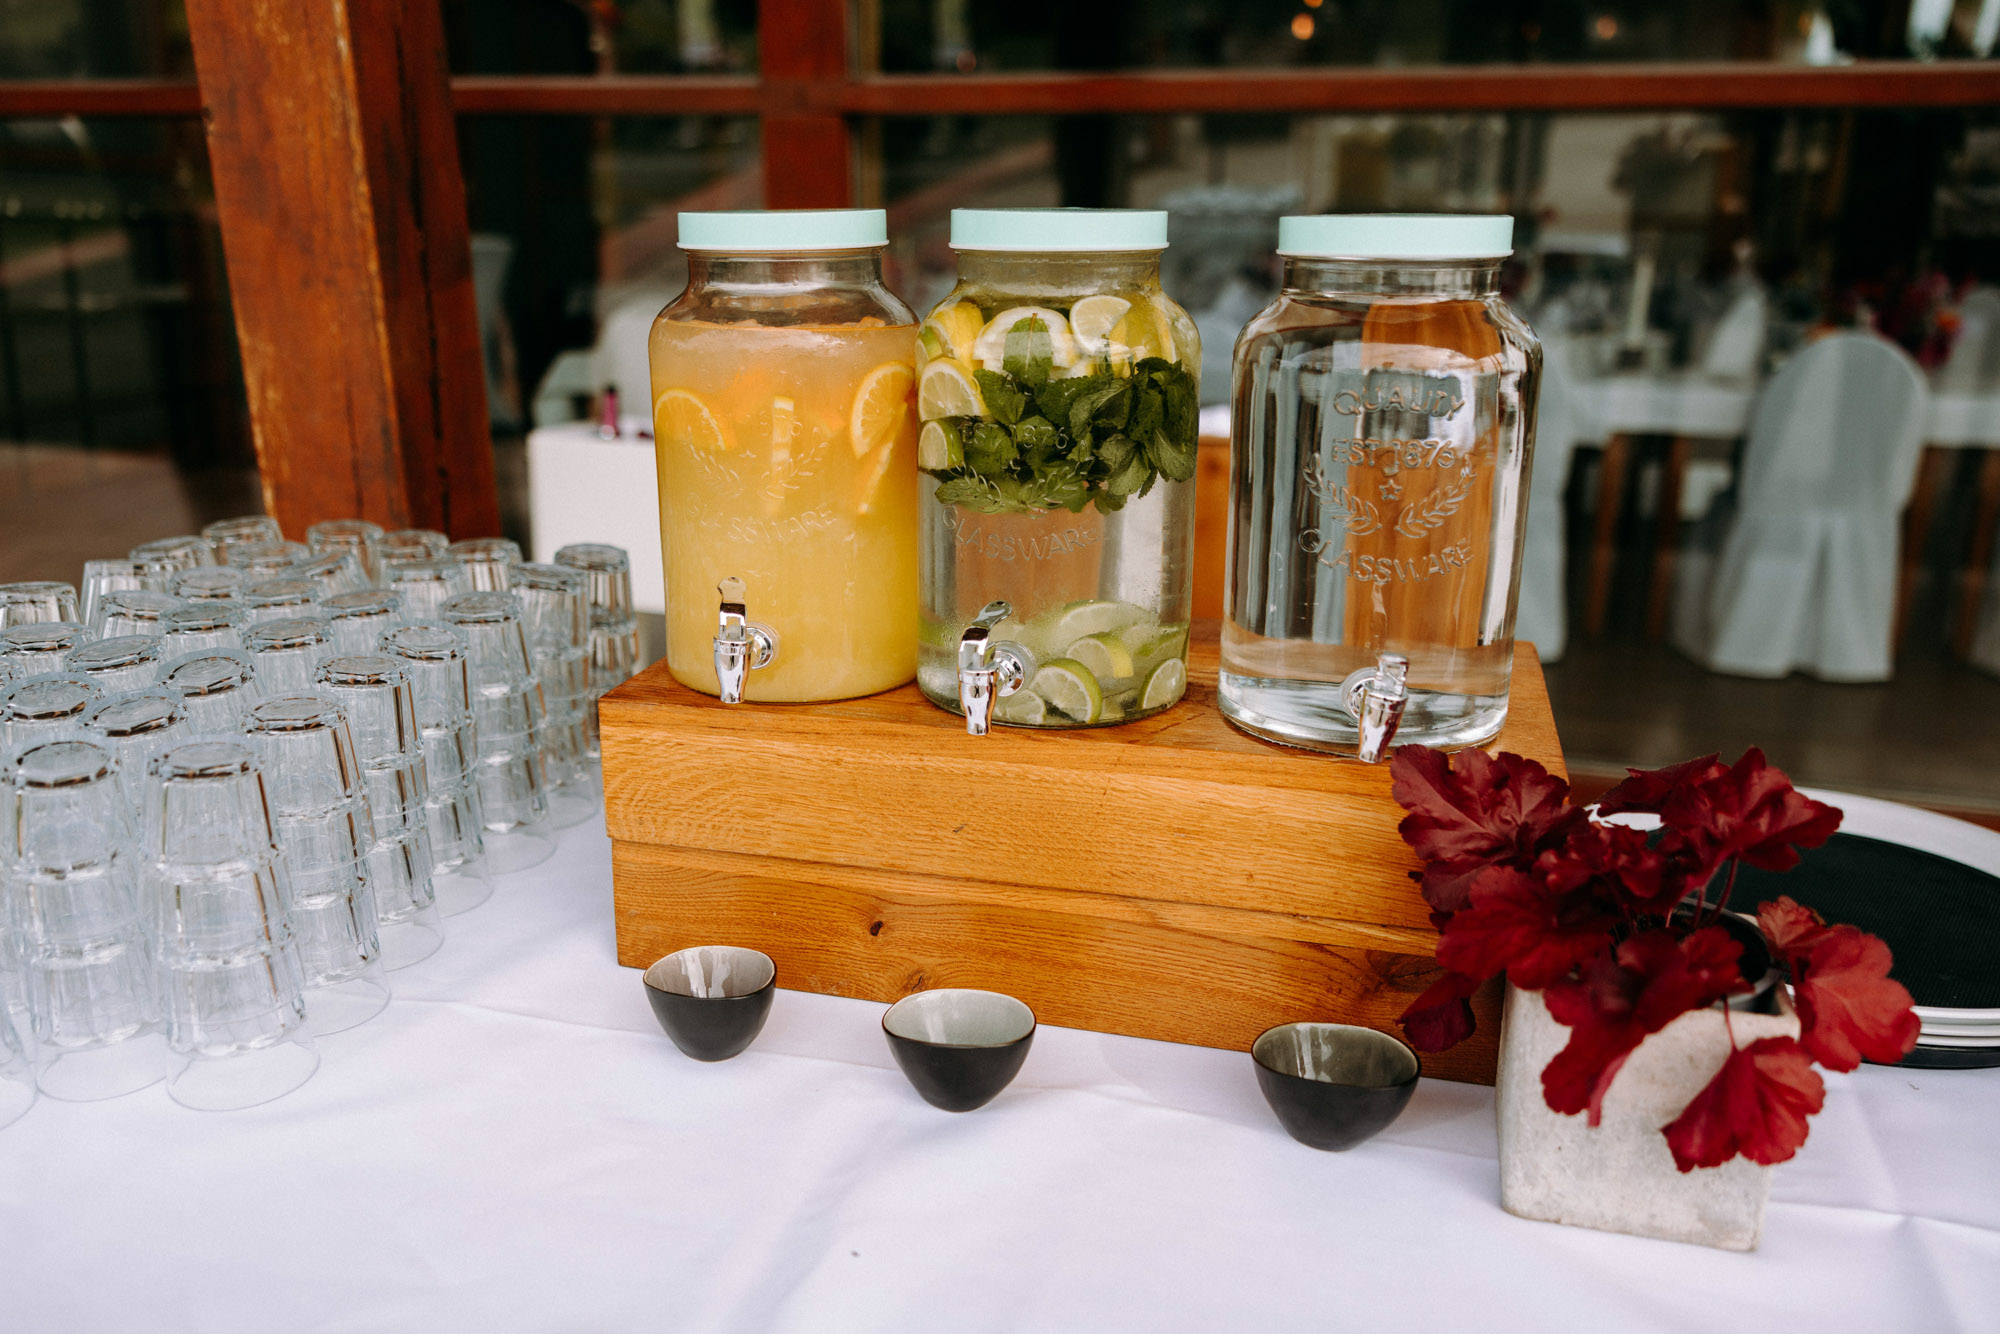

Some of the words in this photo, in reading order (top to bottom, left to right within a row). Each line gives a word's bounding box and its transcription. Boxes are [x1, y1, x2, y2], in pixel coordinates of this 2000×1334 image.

[1333, 386, 1465, 421] QUALITY
[1391, 439, 1456, 468] 1876
[943, 505, 1099, 561] GLASSWARE
[1297, 528, 1475, 584] GLASSWARE
